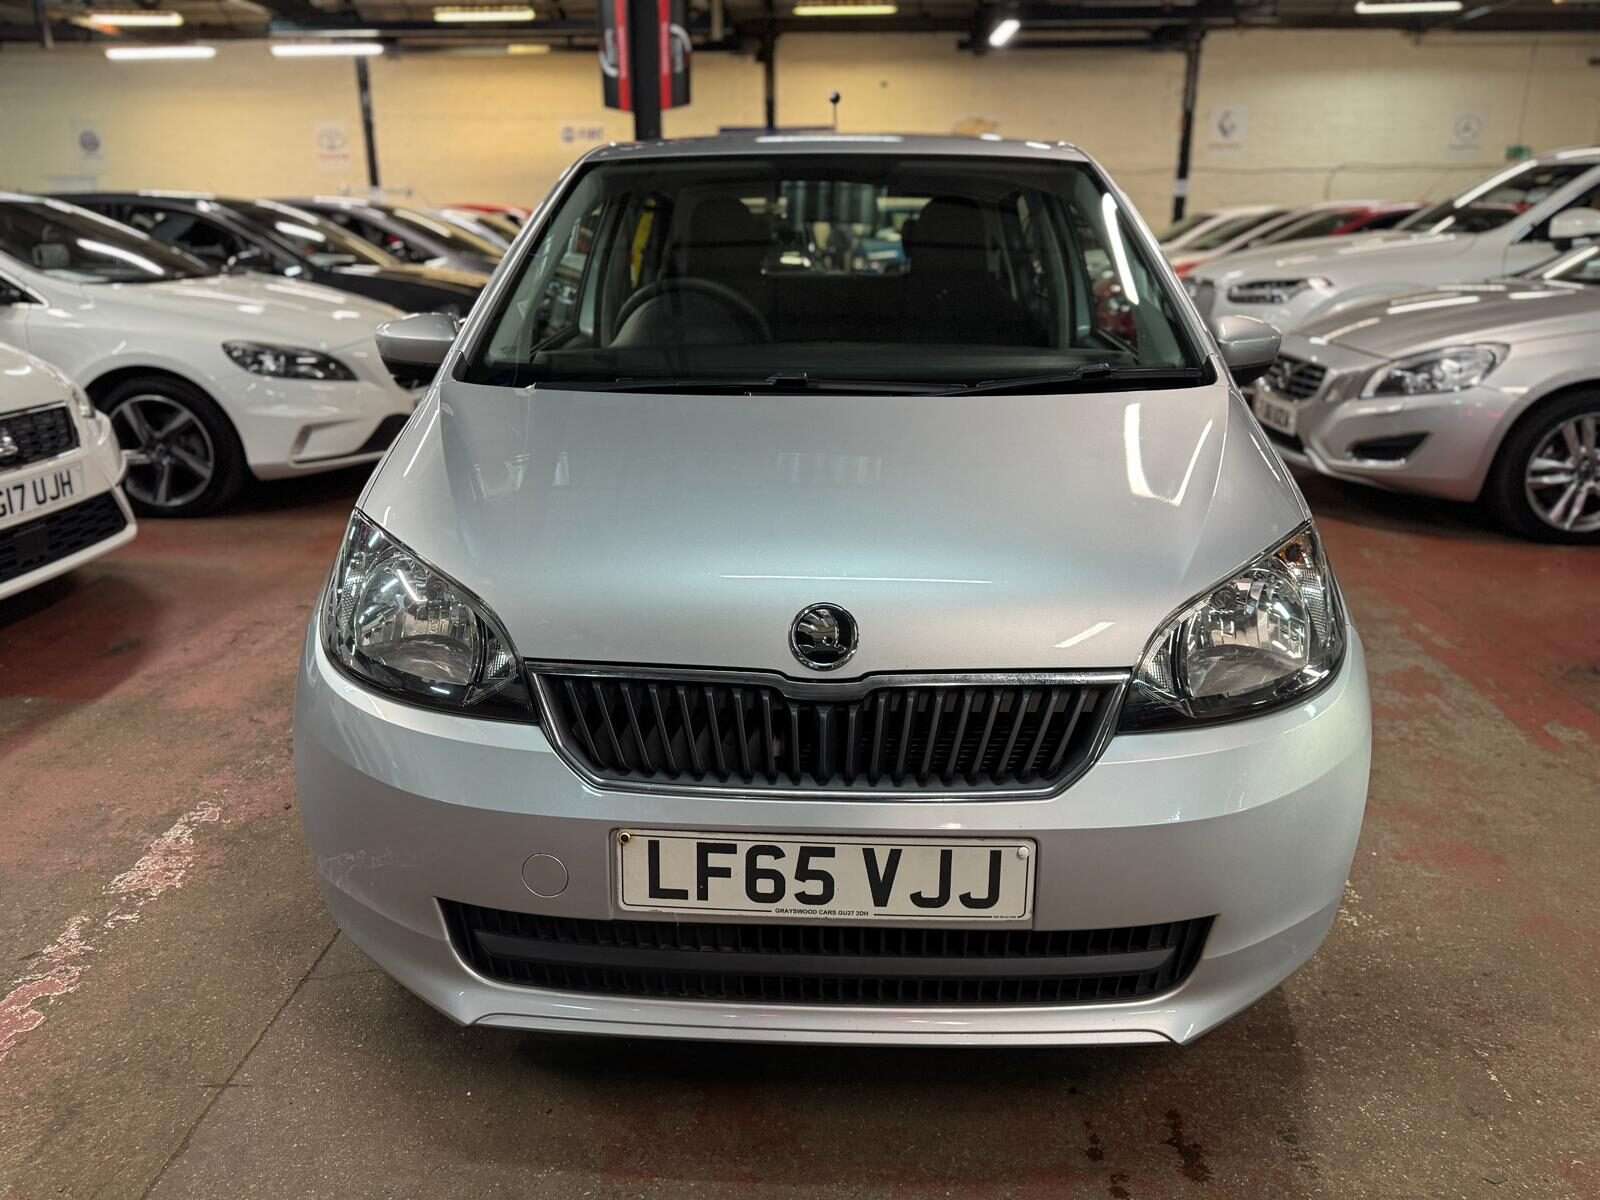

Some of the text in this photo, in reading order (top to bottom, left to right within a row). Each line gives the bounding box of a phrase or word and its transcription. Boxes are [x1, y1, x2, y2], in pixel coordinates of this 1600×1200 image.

[32, 469, 74, 506] UJH
[648, 839, 1002, 909] LF65 VJJ
